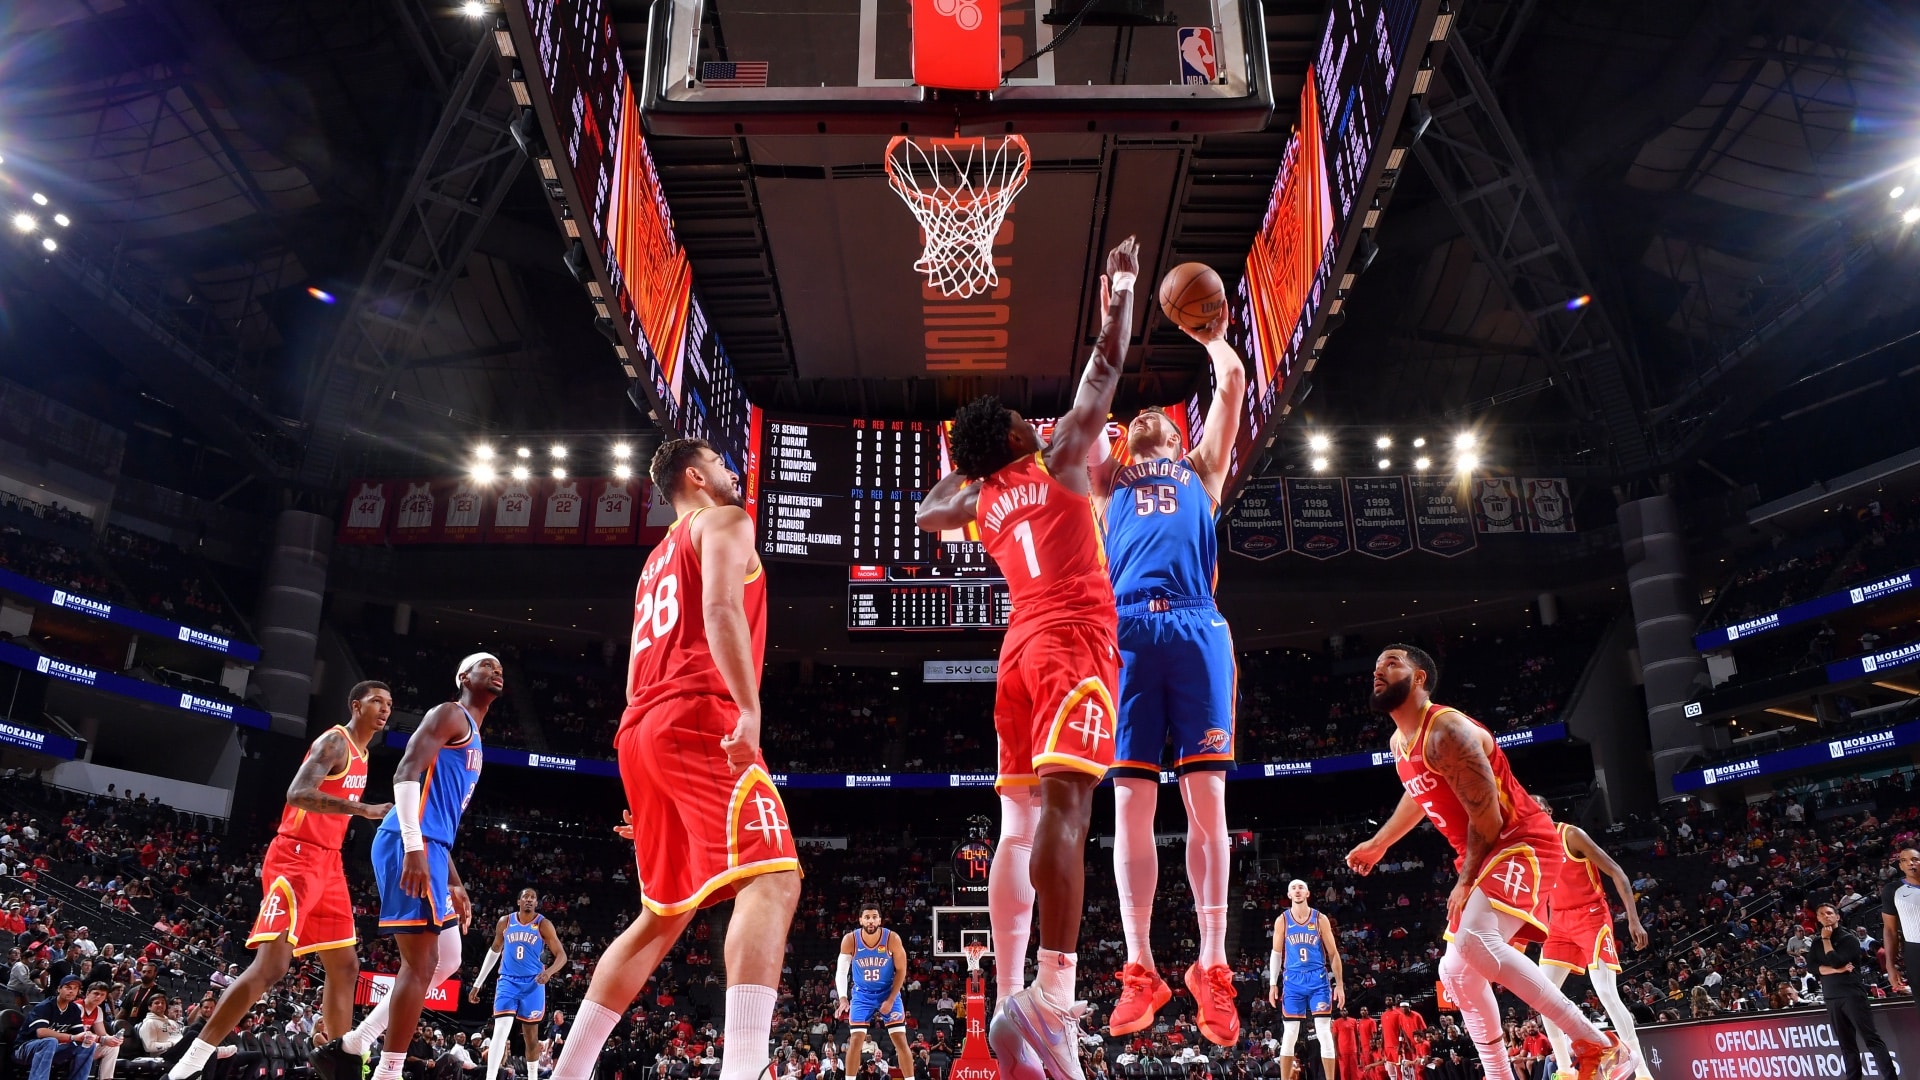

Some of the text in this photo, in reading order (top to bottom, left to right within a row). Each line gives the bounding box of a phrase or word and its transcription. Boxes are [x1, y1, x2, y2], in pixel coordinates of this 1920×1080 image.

[1186, 75, 1204, 86] NBA
[771, 423, 808, 436] 28 SENGUN
[853, 419, 922, 431] PTS REB AST FLS
[773, 435, 808, 448] 7 DURANT
[876, 430, 920, 442] 0 0 0
[771, 447, 813, 460] 10 SMITH JR.
[856, 441, 920, 454] 0 0 0 0
[856, 452, 920, 465] 0 0 0 0
[772, 458, 817, 472] 1 THOMPSON
[856, 464, 920, 476] 2 1 0 0
[770, 470, 812, 483] 5 VANVLEET
[1118, 462, 1192, 487] THUNDER
[855, 476, 920, 488] 0 0 1 0
[851, 488, 922, 500] PTS REB AST FLS
[1135, 484, 1178, 516] 55
[457, 500, 472, 511] 23
[506, 501, 522, 512] 24
[555, 501, 572, 512] 22
[767, 493, 823, 508] 55 HARTENSTEIN
[854, 500, 920, 512] 0 0 0 0
[1242, 499, 1266, 507] 1997
[1304, 499, 1329, 508] 1998
[1366, 498, 1391, 507] 1999
[1428, 496, 1453, 505] 2000
[359, 502, 376, 514] 44
[409, 501, 425, 513] 45
[605, 501, 622, 513] 34
[769, 506, 811, 519] 8 WILLIAMS
[985, 482, 1049, 534] THOMPSON
[1364, 508, 1394, 516] WNBA
[1427, 506, 1457, 515] WNBA
[854, 512, 900, 523] 0 0 0
[1241, 509, 1271, 518] WNBA
[1302, 509, 1332, 518] WNBA
[768, 518, 805, 530] 9 CARUSO
[1231, 519, 1282, 529] Champions
[1293, 519, 1344, 529] Champions
[1355, 518, 1405, 528] Champions
[854, 524, 920, 536] 0 0 0 0
[767, 530, 842, 545] 2 GILGEOUS-ALEXANDER
[854, 536, 920, 548] 0 0 0 0
[765, 542, 808, 555] 25 MITCHELL
[854, 548, 920, 560] 0 1 0 0
[947, 543, 959, 553] TOL
[961, 543, 973, 553] FLS
[1013, 519, 1042, 580] 1
[965, 553, 984, 563] 0 1
[1863, 574, 1911, 594] MOKARAM
[1865, 583, 1913, 600] INJURY LAWYERS
[66, 594, 111, 613] MOKARAM
[1149, 599, 1169, 612] OKC
[64, 603, 109, 619] INJURY LAWYERS
[634, 572, 680, 660] 28
[1738, 614, 1779, 631] MOKARAM
[190, 630, 229, 647] MOKARAM
[50, 661, 96, 679] MOKARAM
[945, 665, 973, 675] SKY
[974, 665, 999, 674] COU
[1878, 659, 1899, 669] INJURY
[49, 670, 94, 685] INJURY LAWYERS
[193, 697, 233, 714] MOKARAM
[1496, 731, 1533, 743] MOKARAM
[1843, 731, 1894, 750] MOKARAM
[18, 740, 42, 750] LAWYERS
[1845, 740, 1896, 755] INJURY LAWYERS
[540, 755, 577, 766] MOKARAM
[1274, 762, 1312, 771] MOKARAM
[1715, 760, 1759, 776] MOKARAM
[341, 774, 368, 789] ROCKE
[1421, 801, 1447, 828] 5
[962, 850, 988, 860] 10:44
[970, 860, 987, 879] 14
[506, 932, 538, 946] THUNDER
[1286, 932, 1318, 946] THUNDER
[516, 945, 524, 960] 8
[1299, 947, 1308, 962] 9
[855, 958, 889, 968] THUNDER
[863, 969, 880, 982] 25
[1715, 1024, 1840, 1053] OFFICIAL VEHICL
[1691, 1051, 1901, 1079] OF THE HOUSTON ROKES
